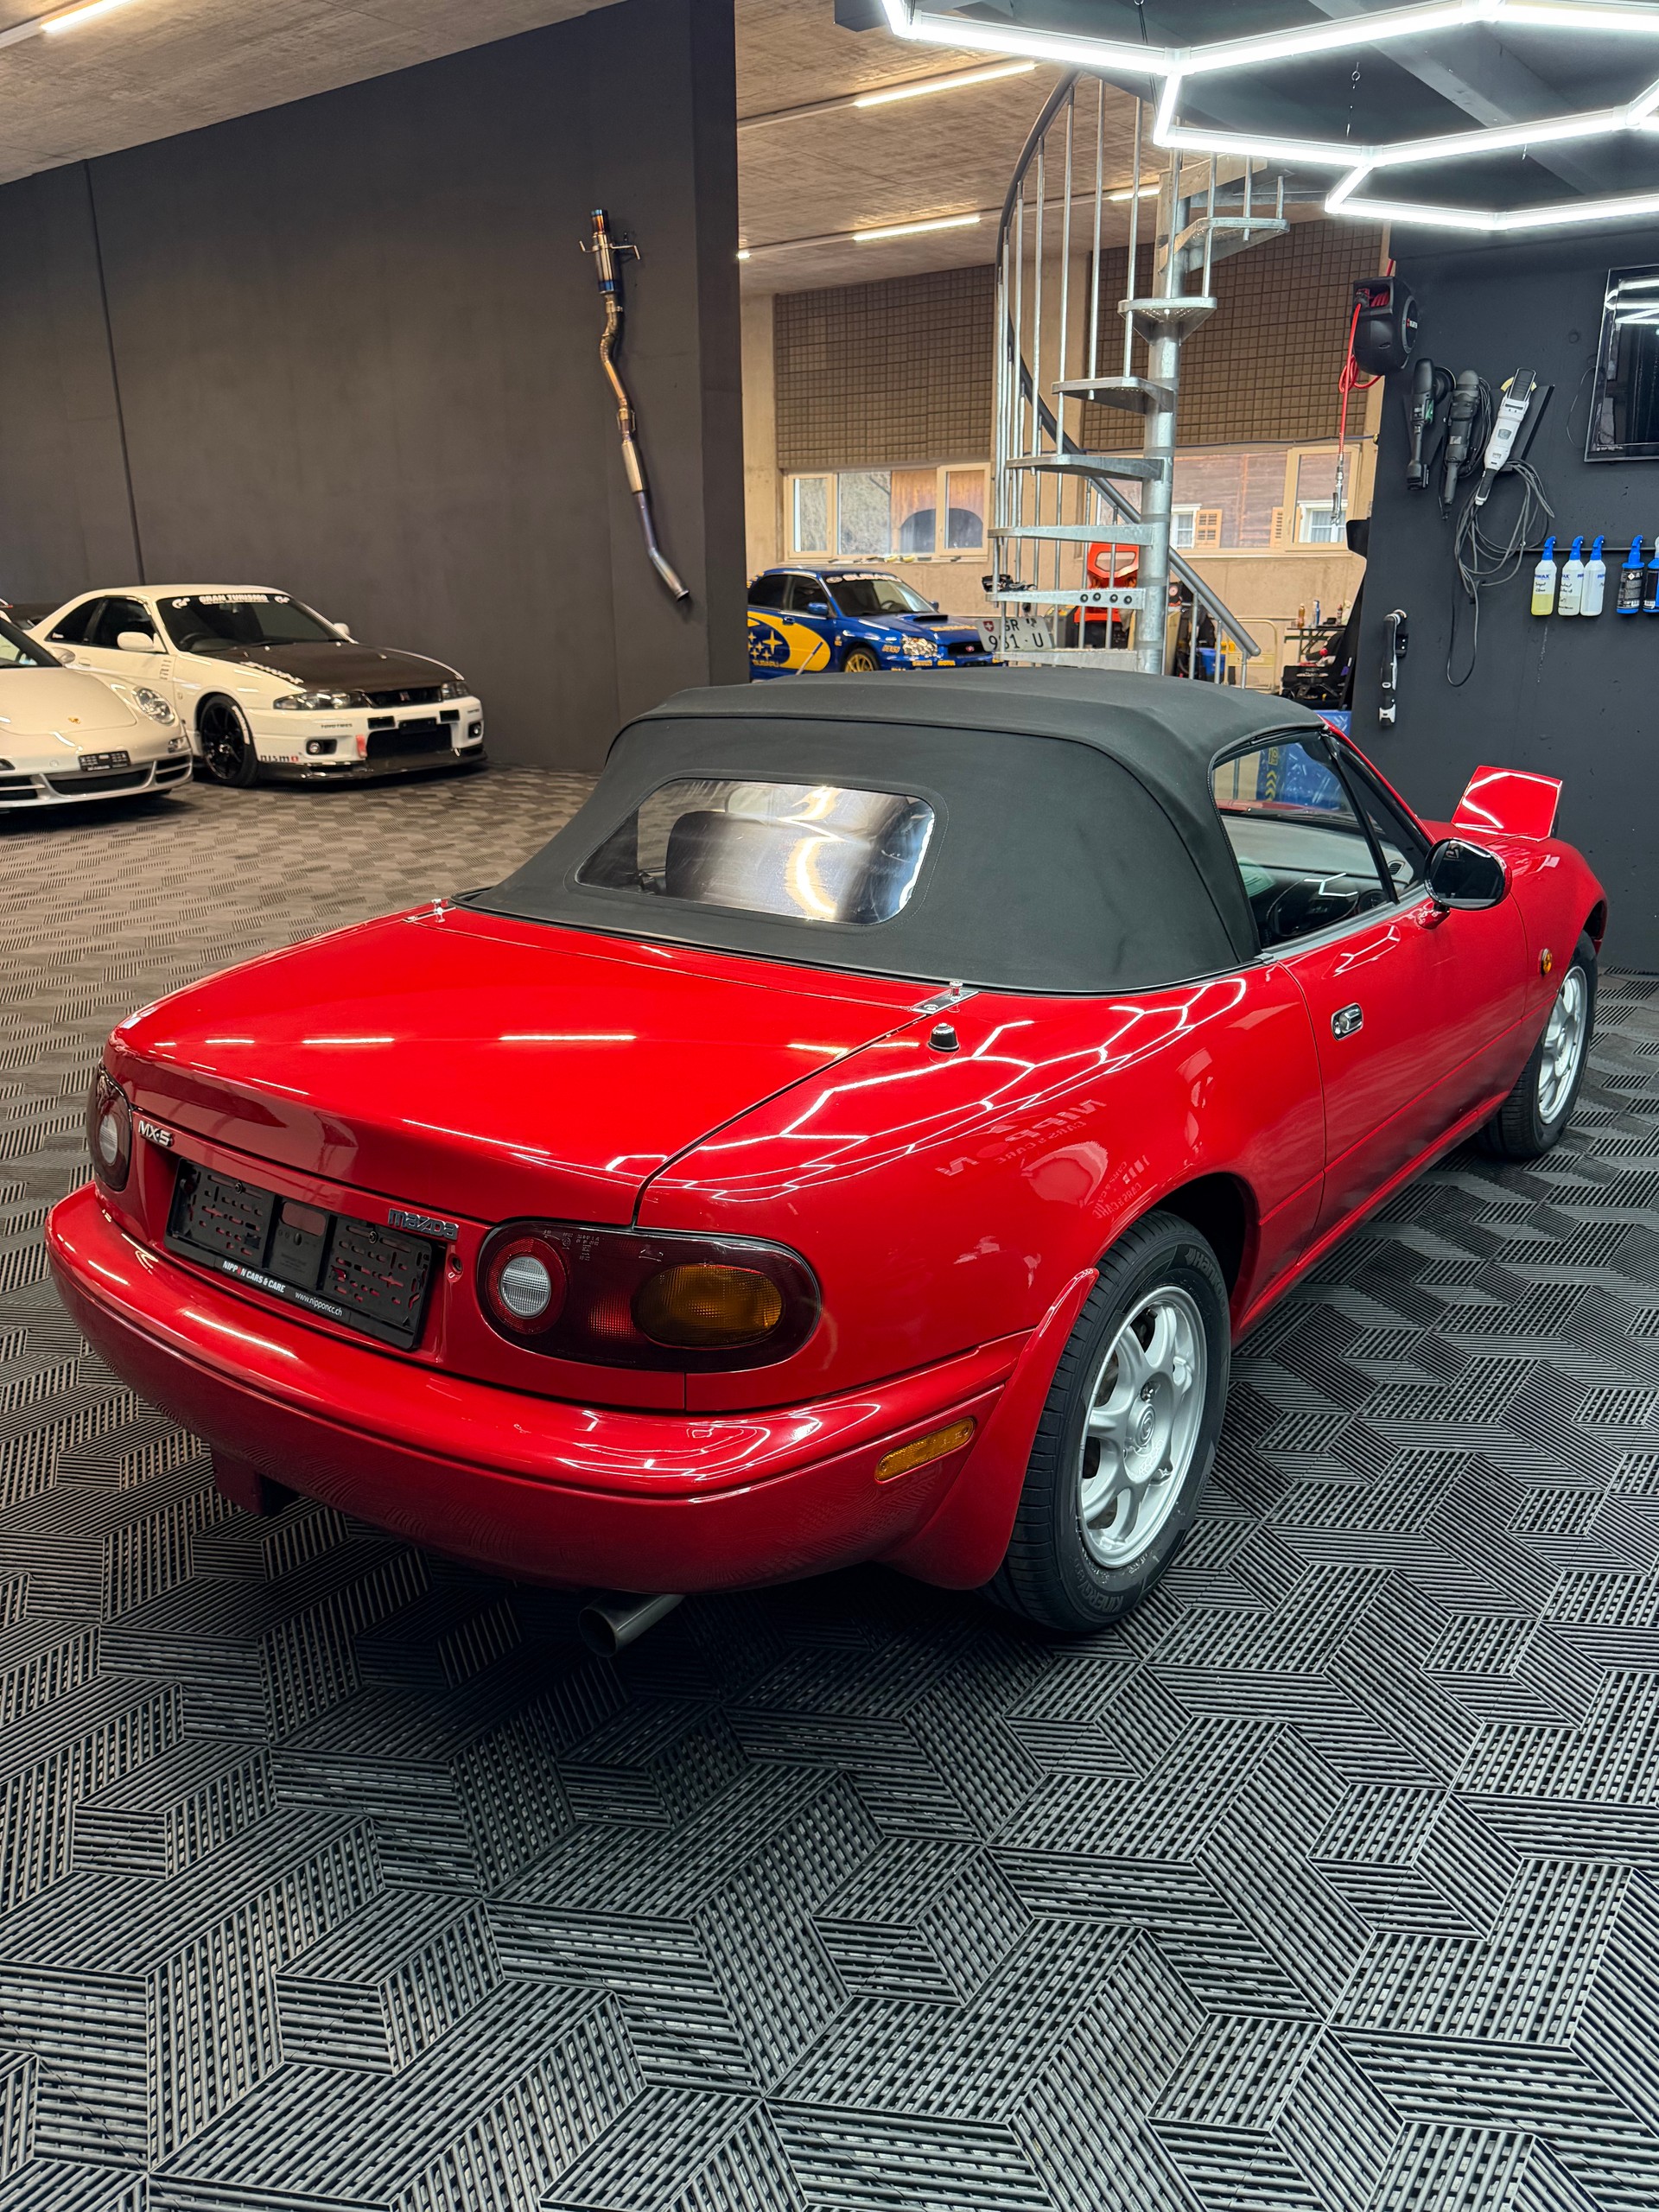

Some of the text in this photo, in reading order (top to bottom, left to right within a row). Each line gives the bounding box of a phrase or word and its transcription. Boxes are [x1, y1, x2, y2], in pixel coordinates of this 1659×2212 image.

[199, 594, 268, 603] GRAN TURISMO
[246, 1271, 263, 1284] CARS
[263, 1277, 268, 1286] &
[268, 1280, 286, 1294] CARE
[295, 1291, 343, 1317] www.nipponcc.ch
